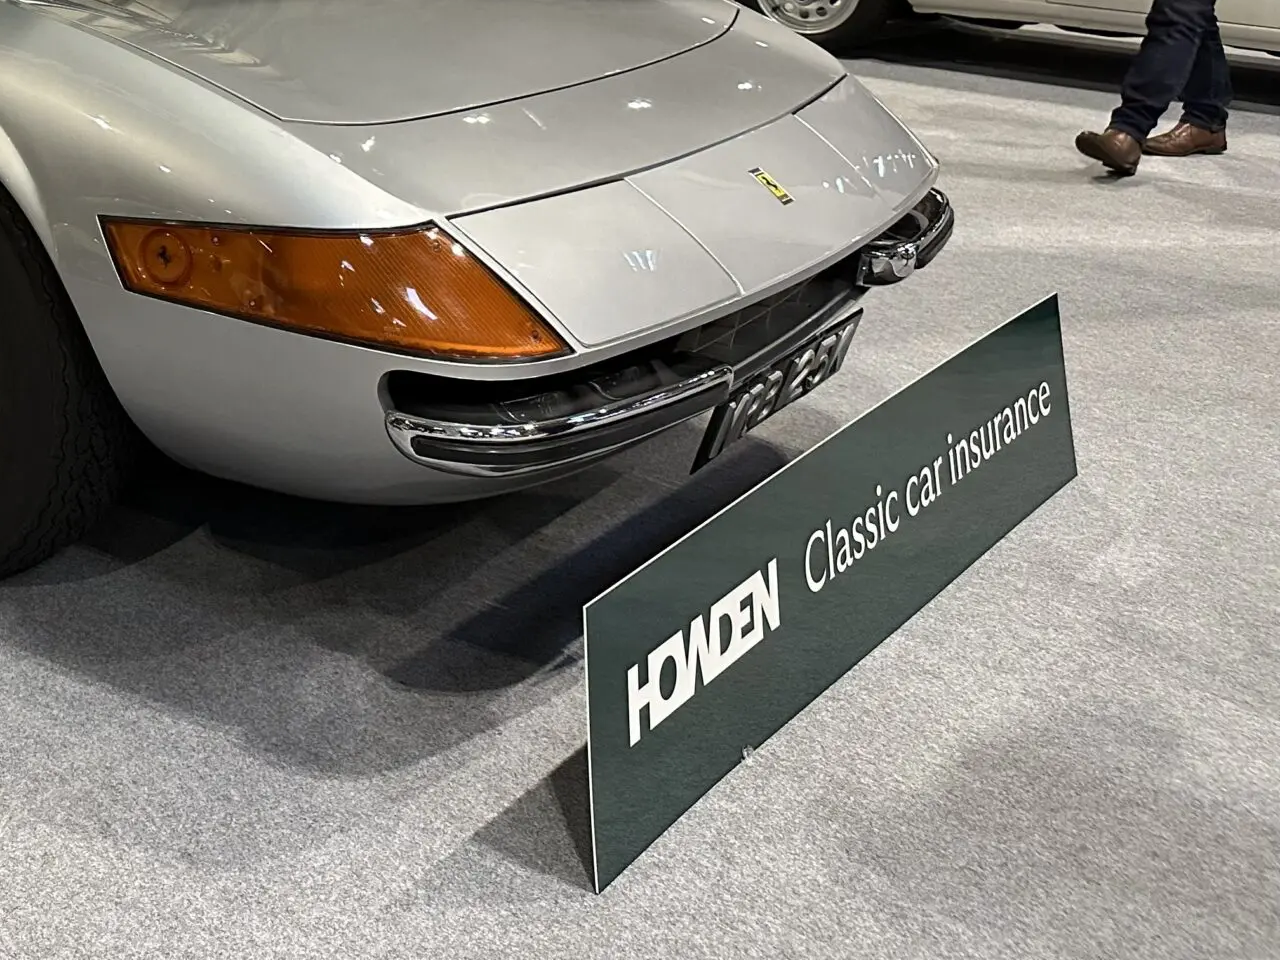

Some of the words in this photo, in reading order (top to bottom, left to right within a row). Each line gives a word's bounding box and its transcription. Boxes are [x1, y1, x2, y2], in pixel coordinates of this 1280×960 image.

[627, 556, 781, 748] HOWDEN
[803, 485, 901, 593] Classic
[906, 455, 943, 517] car
[946, 380, 1052, 486] insurance
